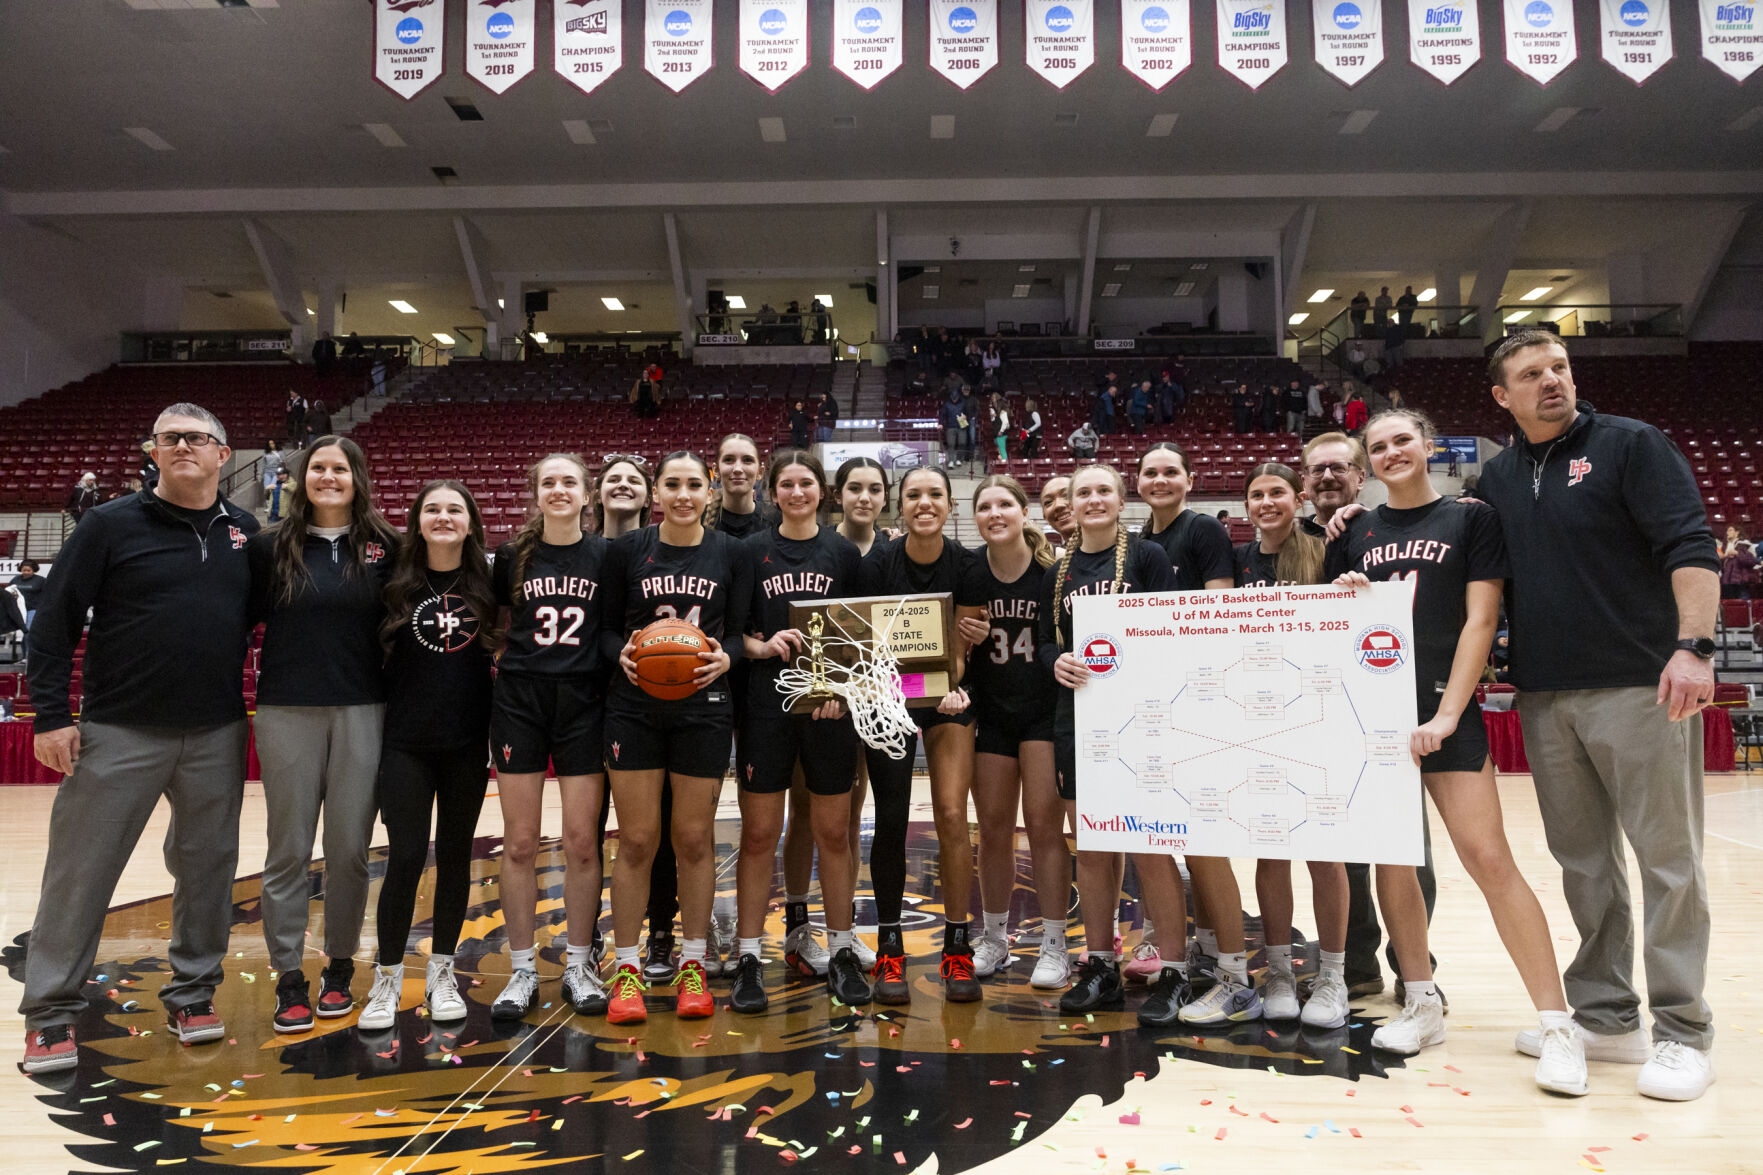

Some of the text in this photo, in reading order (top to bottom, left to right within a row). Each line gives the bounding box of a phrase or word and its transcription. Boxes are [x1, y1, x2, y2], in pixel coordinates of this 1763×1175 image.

[1336, 15, 1361, 23] NCAA
[1426, 8, 1462, 26] BigSky
[1717, 5, 1754, 23] BigSky
[667, 22, 691, 30] NCAA
[1048, 18, 1073, 26] NCAA
[1234, 11, 1271, 30] BigSky
[399, 30, 423, 38] NCAA
[1418, 39, 1472, 47] CHAMPIONS
[1709, 36, 1763, 44] CHAMPIONS
[562, 46, 615, 56] CHAMPIONS
[1225, 42, 1280, 51] CHAMPIONS
[1336, 56, 1365, 66] 1997
[1431, 54, 1461, 65] 1995
[1528, 54, 1557, 64] 1992
[1624, 53, 1652, 63] 1991
[1724, 52, 1754, 61] 1986
[574, 62, 603, 73] 2015
[663, 62, 692, 72] 2013
[758, 61, 787, 71] 2012
[854, 60, 883, 70] 2010
[948, 59, 980, 69] 2006
[1044, 58, 1076, 68] 2005
[1142, 60, 1173, 70] 2002
[1237, 58, 1270, 69] 2000
[394, 69, 423, 80] 2019
[485, 65, 514, 75] 2018
[1363, 540, 1451, 571] PROJECT
[523, 576, 598, 600] PROJECT
[641, 575, 718, 600] PROJECT
[763, 572, 833, 599] PROJECT
[1118, 599, 1144, 608] 2025
[1148, 597, 1175, 607] Class
[1179, 596, 1186, 605] B
[1223, 592, 1281, 603] Basketball
[1285, 590, 1356, 601] Tournament
[1172, 608, 1296, 620] U of M Adams Center
[534, 606, 585, 646] 32
[1126, 628, 1175, 637] Missoula,
[1180, 626, 1228, 635] Montana
[1239, 623, 1274, 633] March
[1279, 622, 1315, 632] 13-15,
[1320, 620, 1349, 631] 2025
[892, 631, 922, 640] STATE
[1356, 629, 1372, 651] MONTANA
[1392, 629, 1406, 649] SCHOOL
[682, 635, 701, 648] PRO
[990, 627, 1034, 664] 34
[1085, 657, 1119, 669] MHSA
[1360, 650, 1404, 665] MHSA
[1364, 663, 1400, 673] ASSOCIATION
[1080, 814, 1187, 834] NorthWestern
[1149, 834, 1188, 851] Energy
